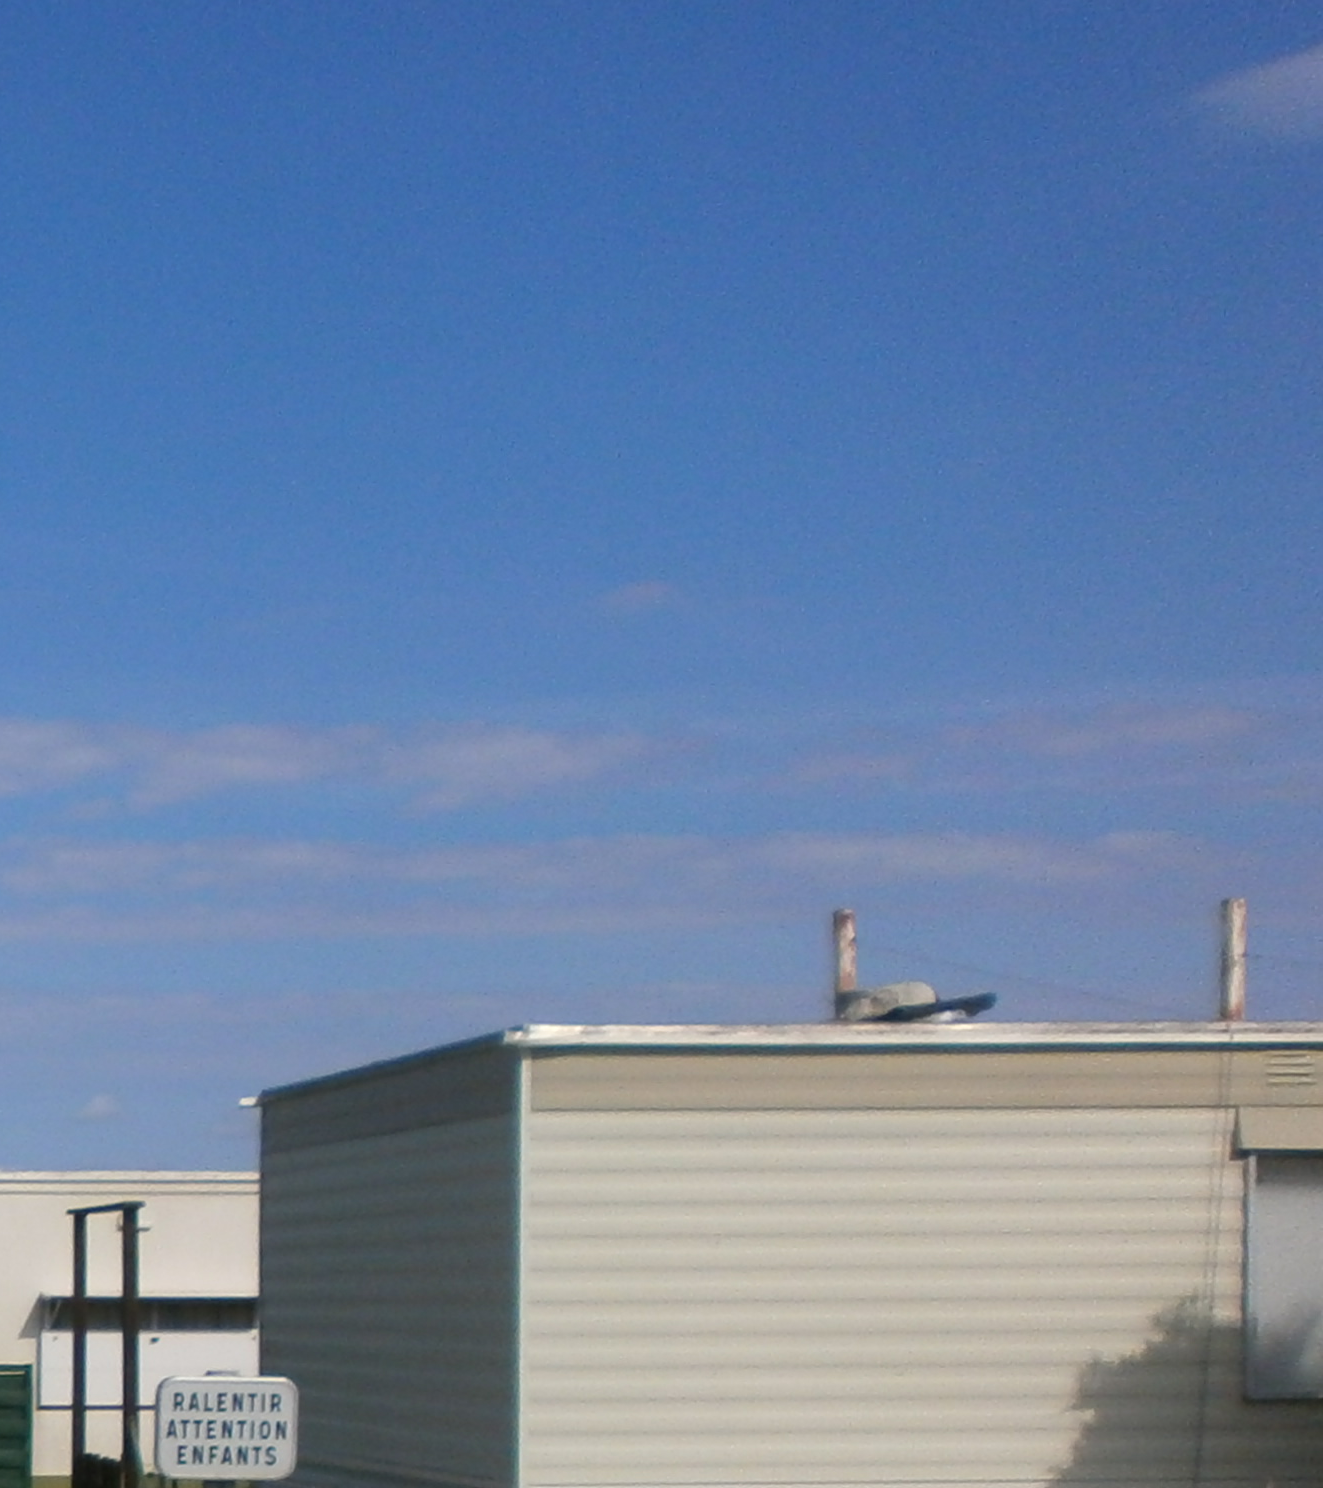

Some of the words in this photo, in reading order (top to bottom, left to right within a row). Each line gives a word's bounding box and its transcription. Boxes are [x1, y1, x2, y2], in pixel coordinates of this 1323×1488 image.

[173, 1392, 282, 1412] RALENTIR
[166, 1419, 288, 1440] ATTENTION
[176, 1445, 277, 1465] ENFANTS
